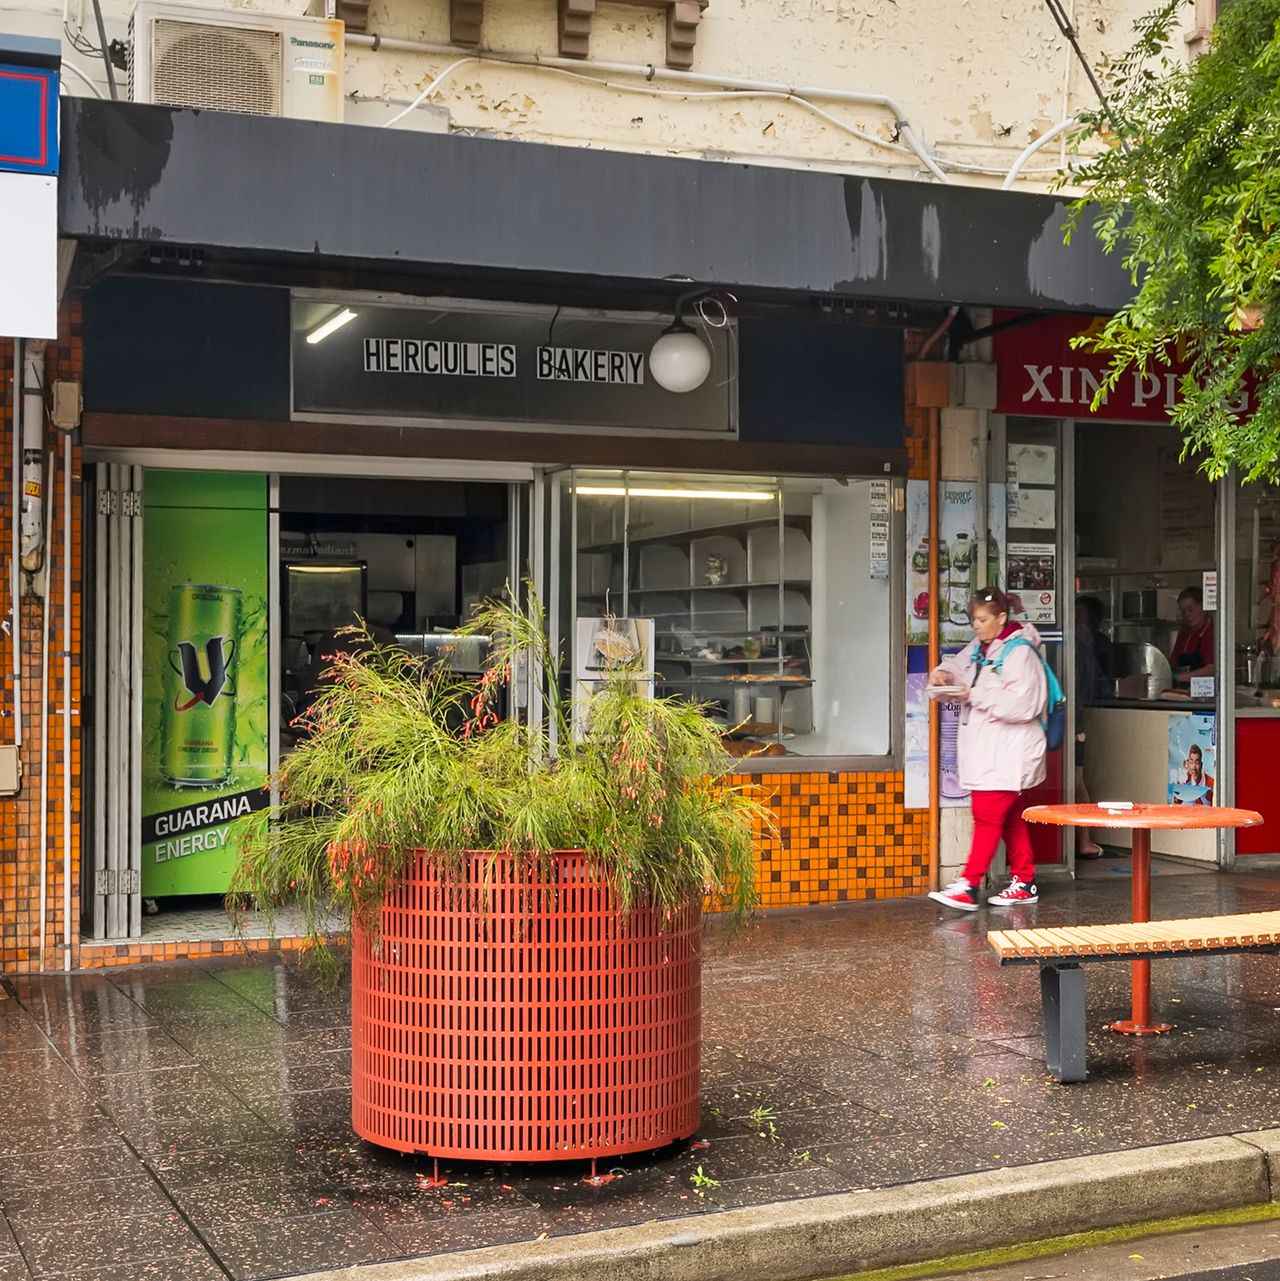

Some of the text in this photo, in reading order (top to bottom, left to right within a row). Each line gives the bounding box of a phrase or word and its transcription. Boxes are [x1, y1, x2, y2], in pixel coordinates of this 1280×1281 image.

[365, 338, 644, 384] HERCULES BAKERY
[1022, 364, 1250, 413] XIN PIG
[155, 795, 253, 837] GUARANA
[155, 827, 230, 864] ENERGY
